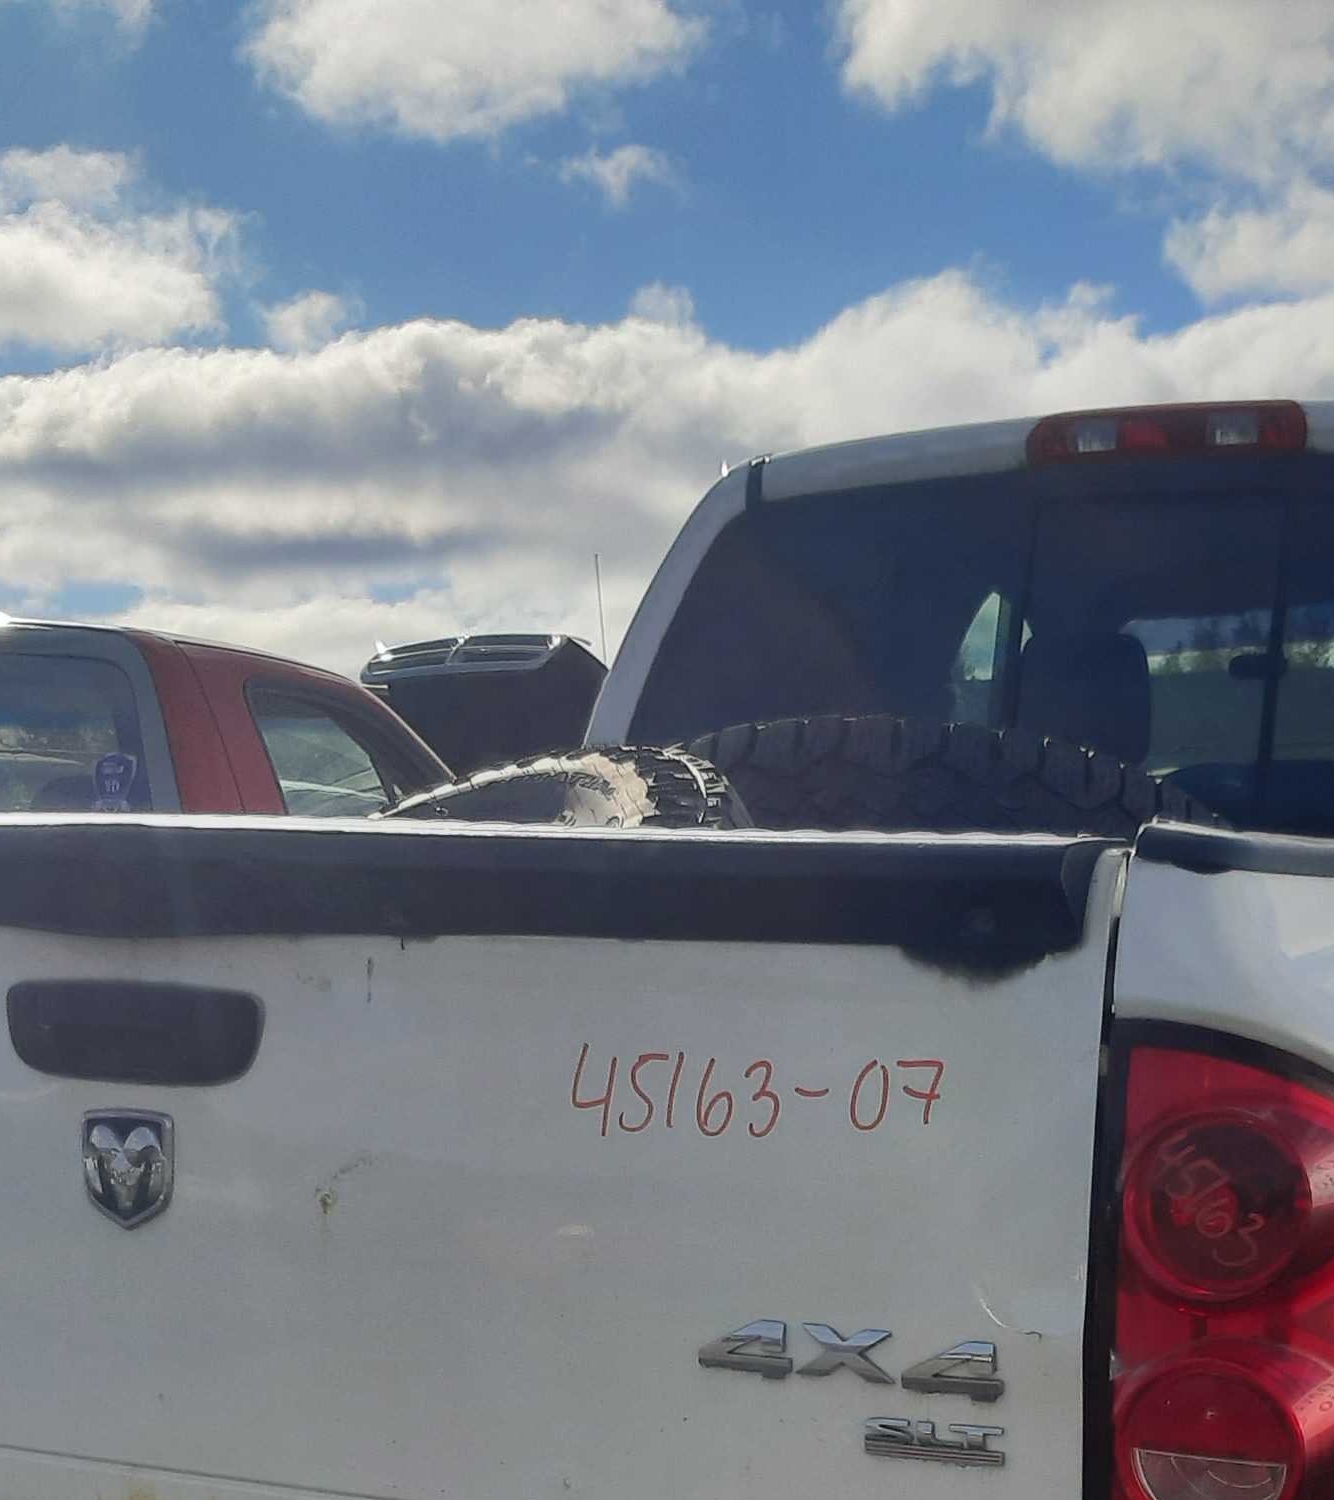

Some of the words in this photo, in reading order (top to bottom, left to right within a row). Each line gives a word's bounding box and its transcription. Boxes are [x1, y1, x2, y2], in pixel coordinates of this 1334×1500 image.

[570, 1042, 946, 1137] 45163-07
[1156, 1126, 1266, 1267] 45163
[698, 1319, 1005, 1403] 4X4
[864, 1417, 1005, 1453] SLT
